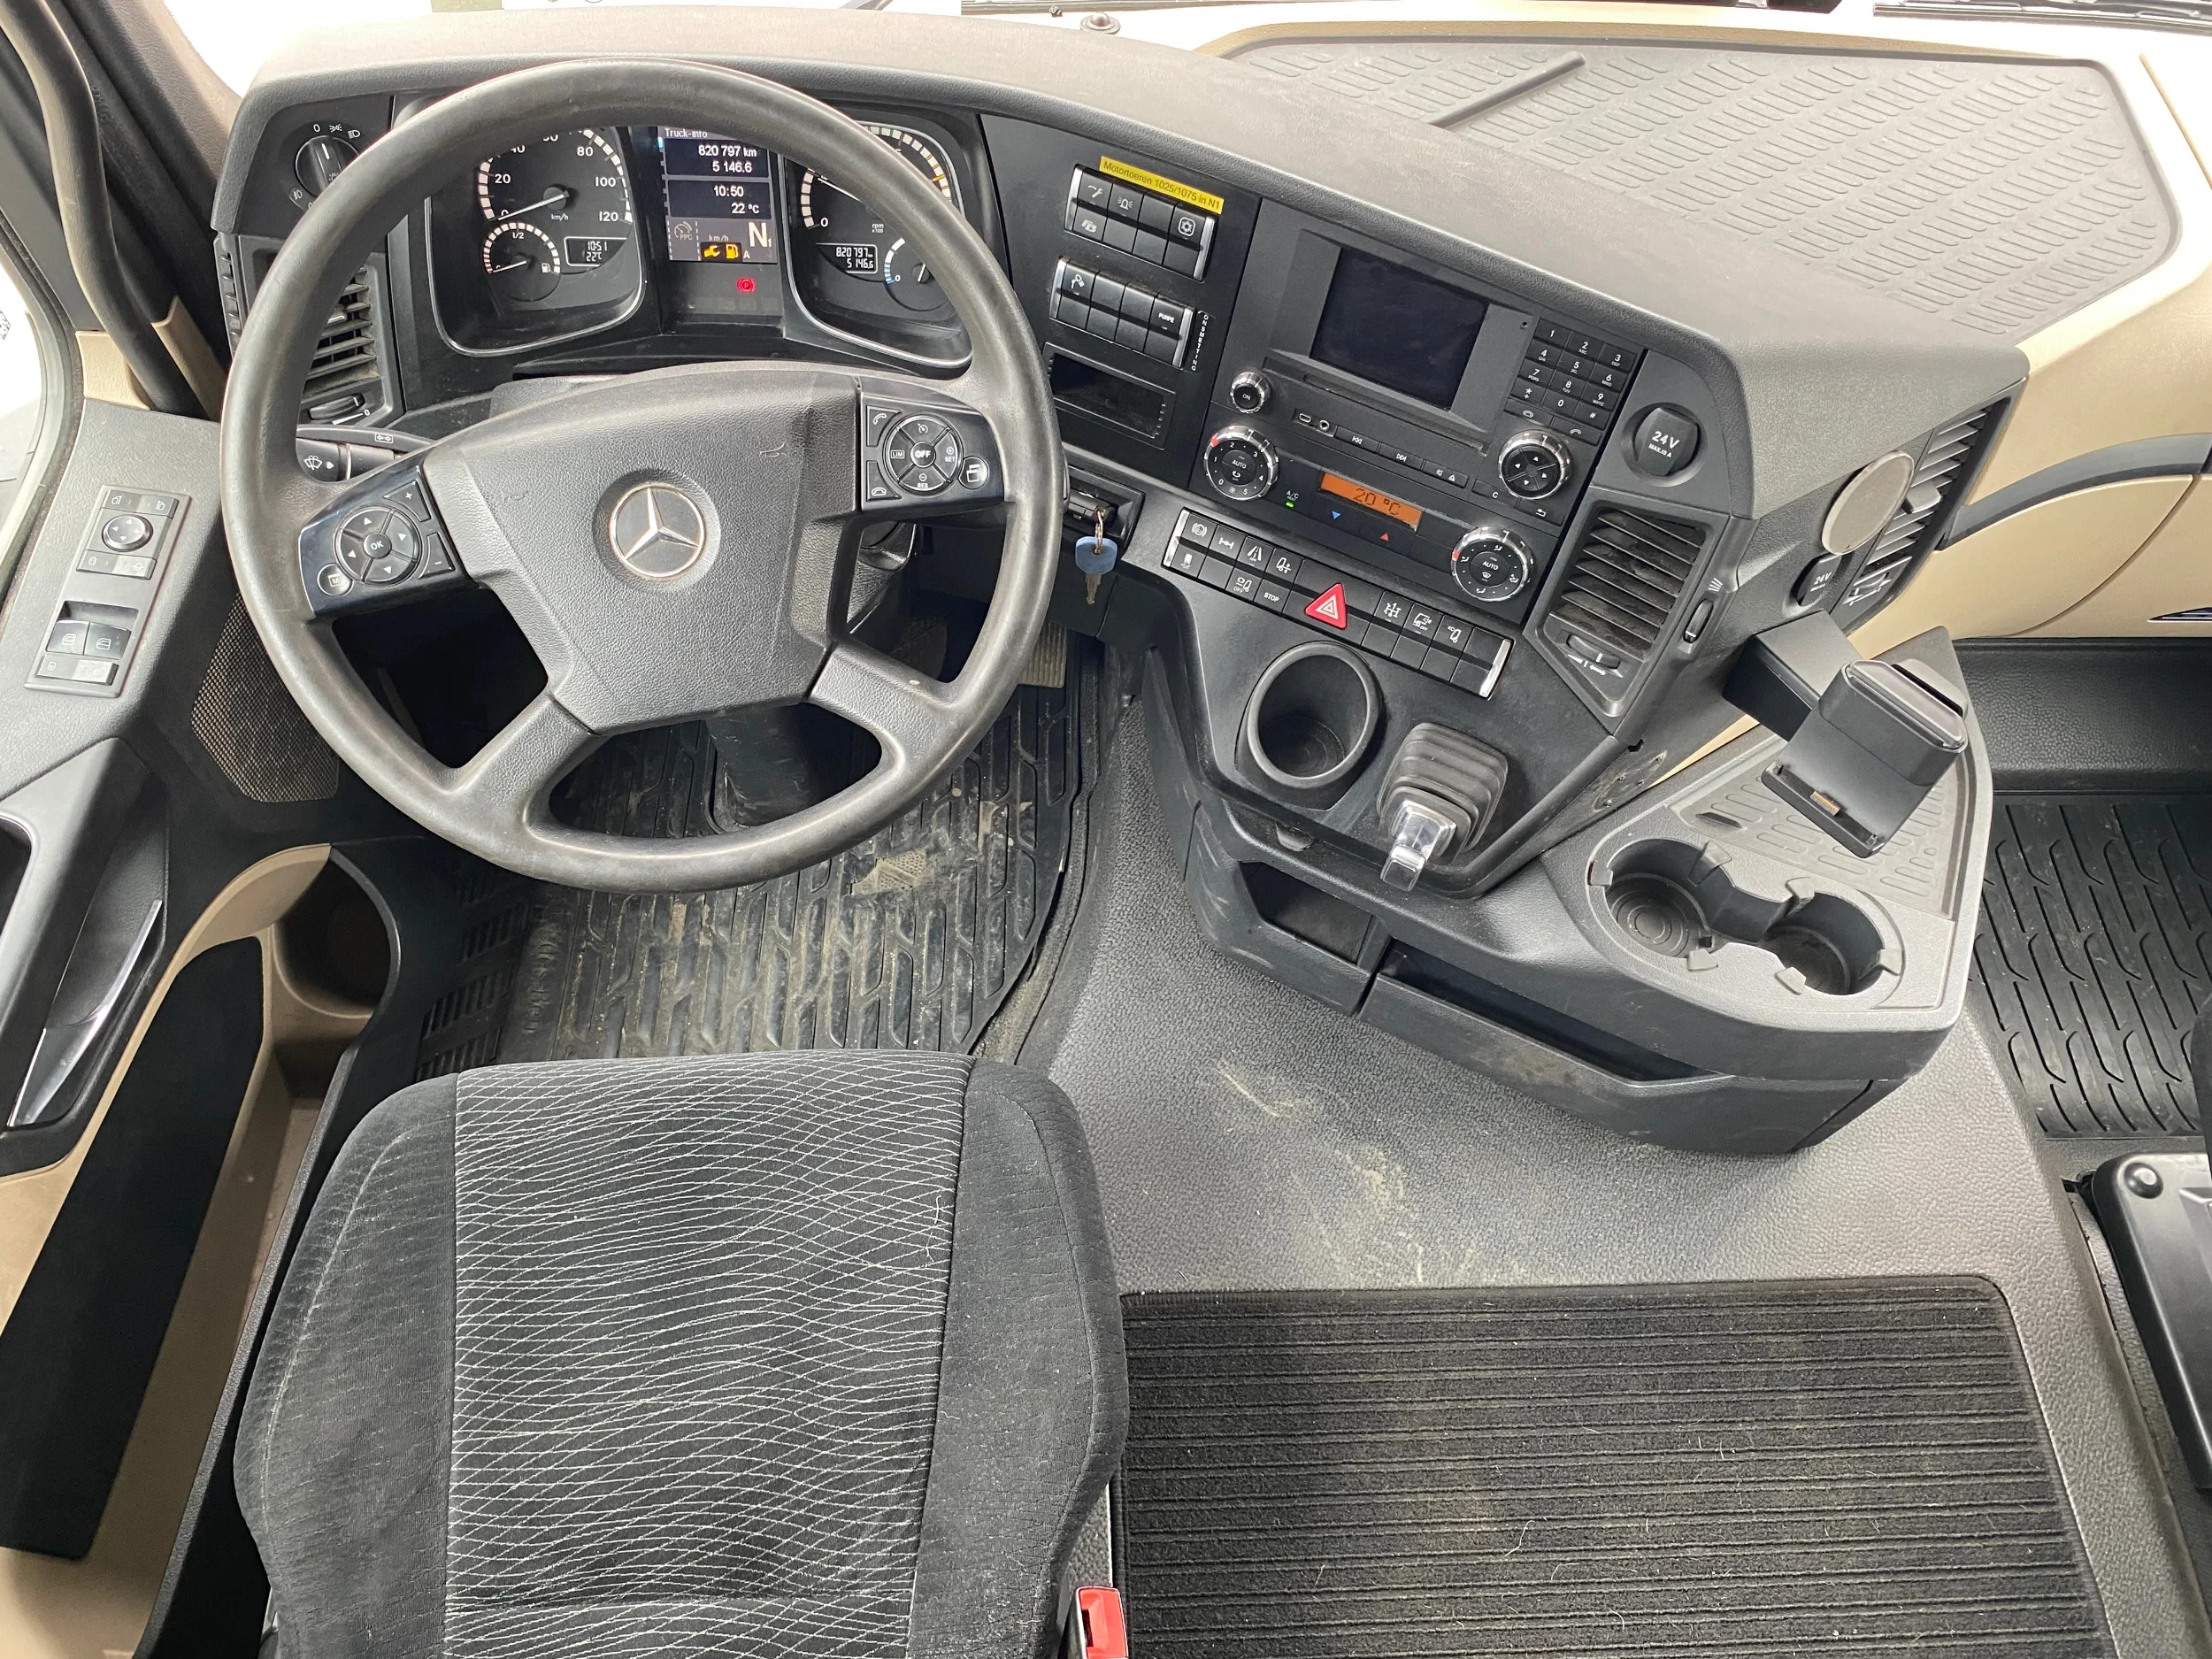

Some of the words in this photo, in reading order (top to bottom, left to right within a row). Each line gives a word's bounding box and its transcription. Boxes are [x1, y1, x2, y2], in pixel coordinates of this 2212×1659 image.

[313, 123, 320, 132] 0
[664, 127, 708, 138] Truck-info
[577, 146, 593, 157] 80
[698, 144, 718, 157] 820
[721, 145, 741, 157] 797
[743, 147, 757, 157] km
[712, 160, 719, 172] 5
[724, 161, 752, 173] 146.6
[495, 173, 511, 183] 20
[595, 176, 616, 187] 100
[714, 185, 744, 196] 10:50
[1103, 161, 1152, 185] Motortoeren
[1155, 180, 1197, 201] 1025/1075
[1199, 196, 1206, 204] in
[1209, 199, 1219, 210] N1
[731, 202, 745, 213] 22
[748, 204, 759, 214] °C
[599, 211, 618, 221] 120
[820, 218, 829, 227] 0
[748, 221, 768, 248] N
[588, 241, 608, 251] 10:51
[743, 250, 750, 259] A
[836, 247, 851, 257] 820
[847, 258, 852, 268] 5
[1191, 314, 1210, 371] ONSMETTING
[1651, 430, 1680, 449] 24V
[914, 449, 931, 458] OFF
[1232, 459, 1247, 469] AUTO
[1286, 490, 1299, 499] A/C
[1353, 488, 1377, 506] 20
[370, 540, 385, 551] OK
[1482, 560, 1499, 571] AUTO
[1813, 571, 1832, 585] 24V
[1263, 592, 1279, 603] STOP
